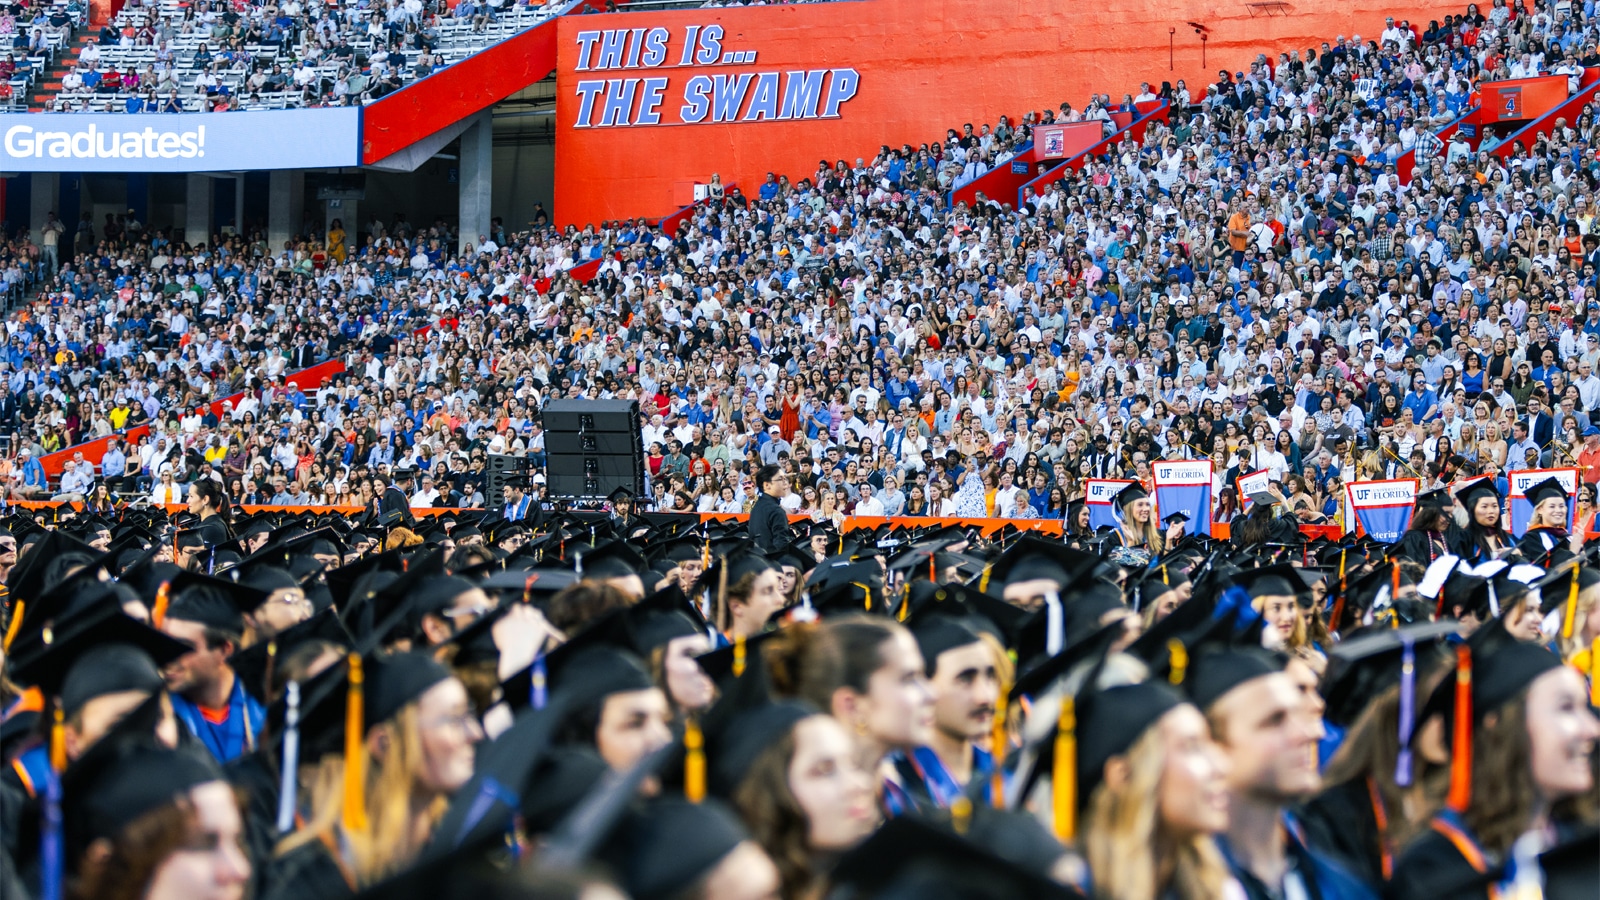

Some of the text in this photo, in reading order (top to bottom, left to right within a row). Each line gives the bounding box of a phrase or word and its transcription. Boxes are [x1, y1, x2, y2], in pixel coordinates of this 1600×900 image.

[574, 24, 757, 71] THIS IS...
[573, 68, 860, 128] THE SWAMP
[1505, 98, 1515, 111] 4
[4, 123, 206, 158] Graduates!
[1051, 140, 1057, 150] 2
[1160, 469, 1205, 479] UF FLORIDA
[1517, 478, 1531, 488] UF
[1092, 485, 1105, 495] UF
[1356, 489, 1412, 500] UF FLORIDA
